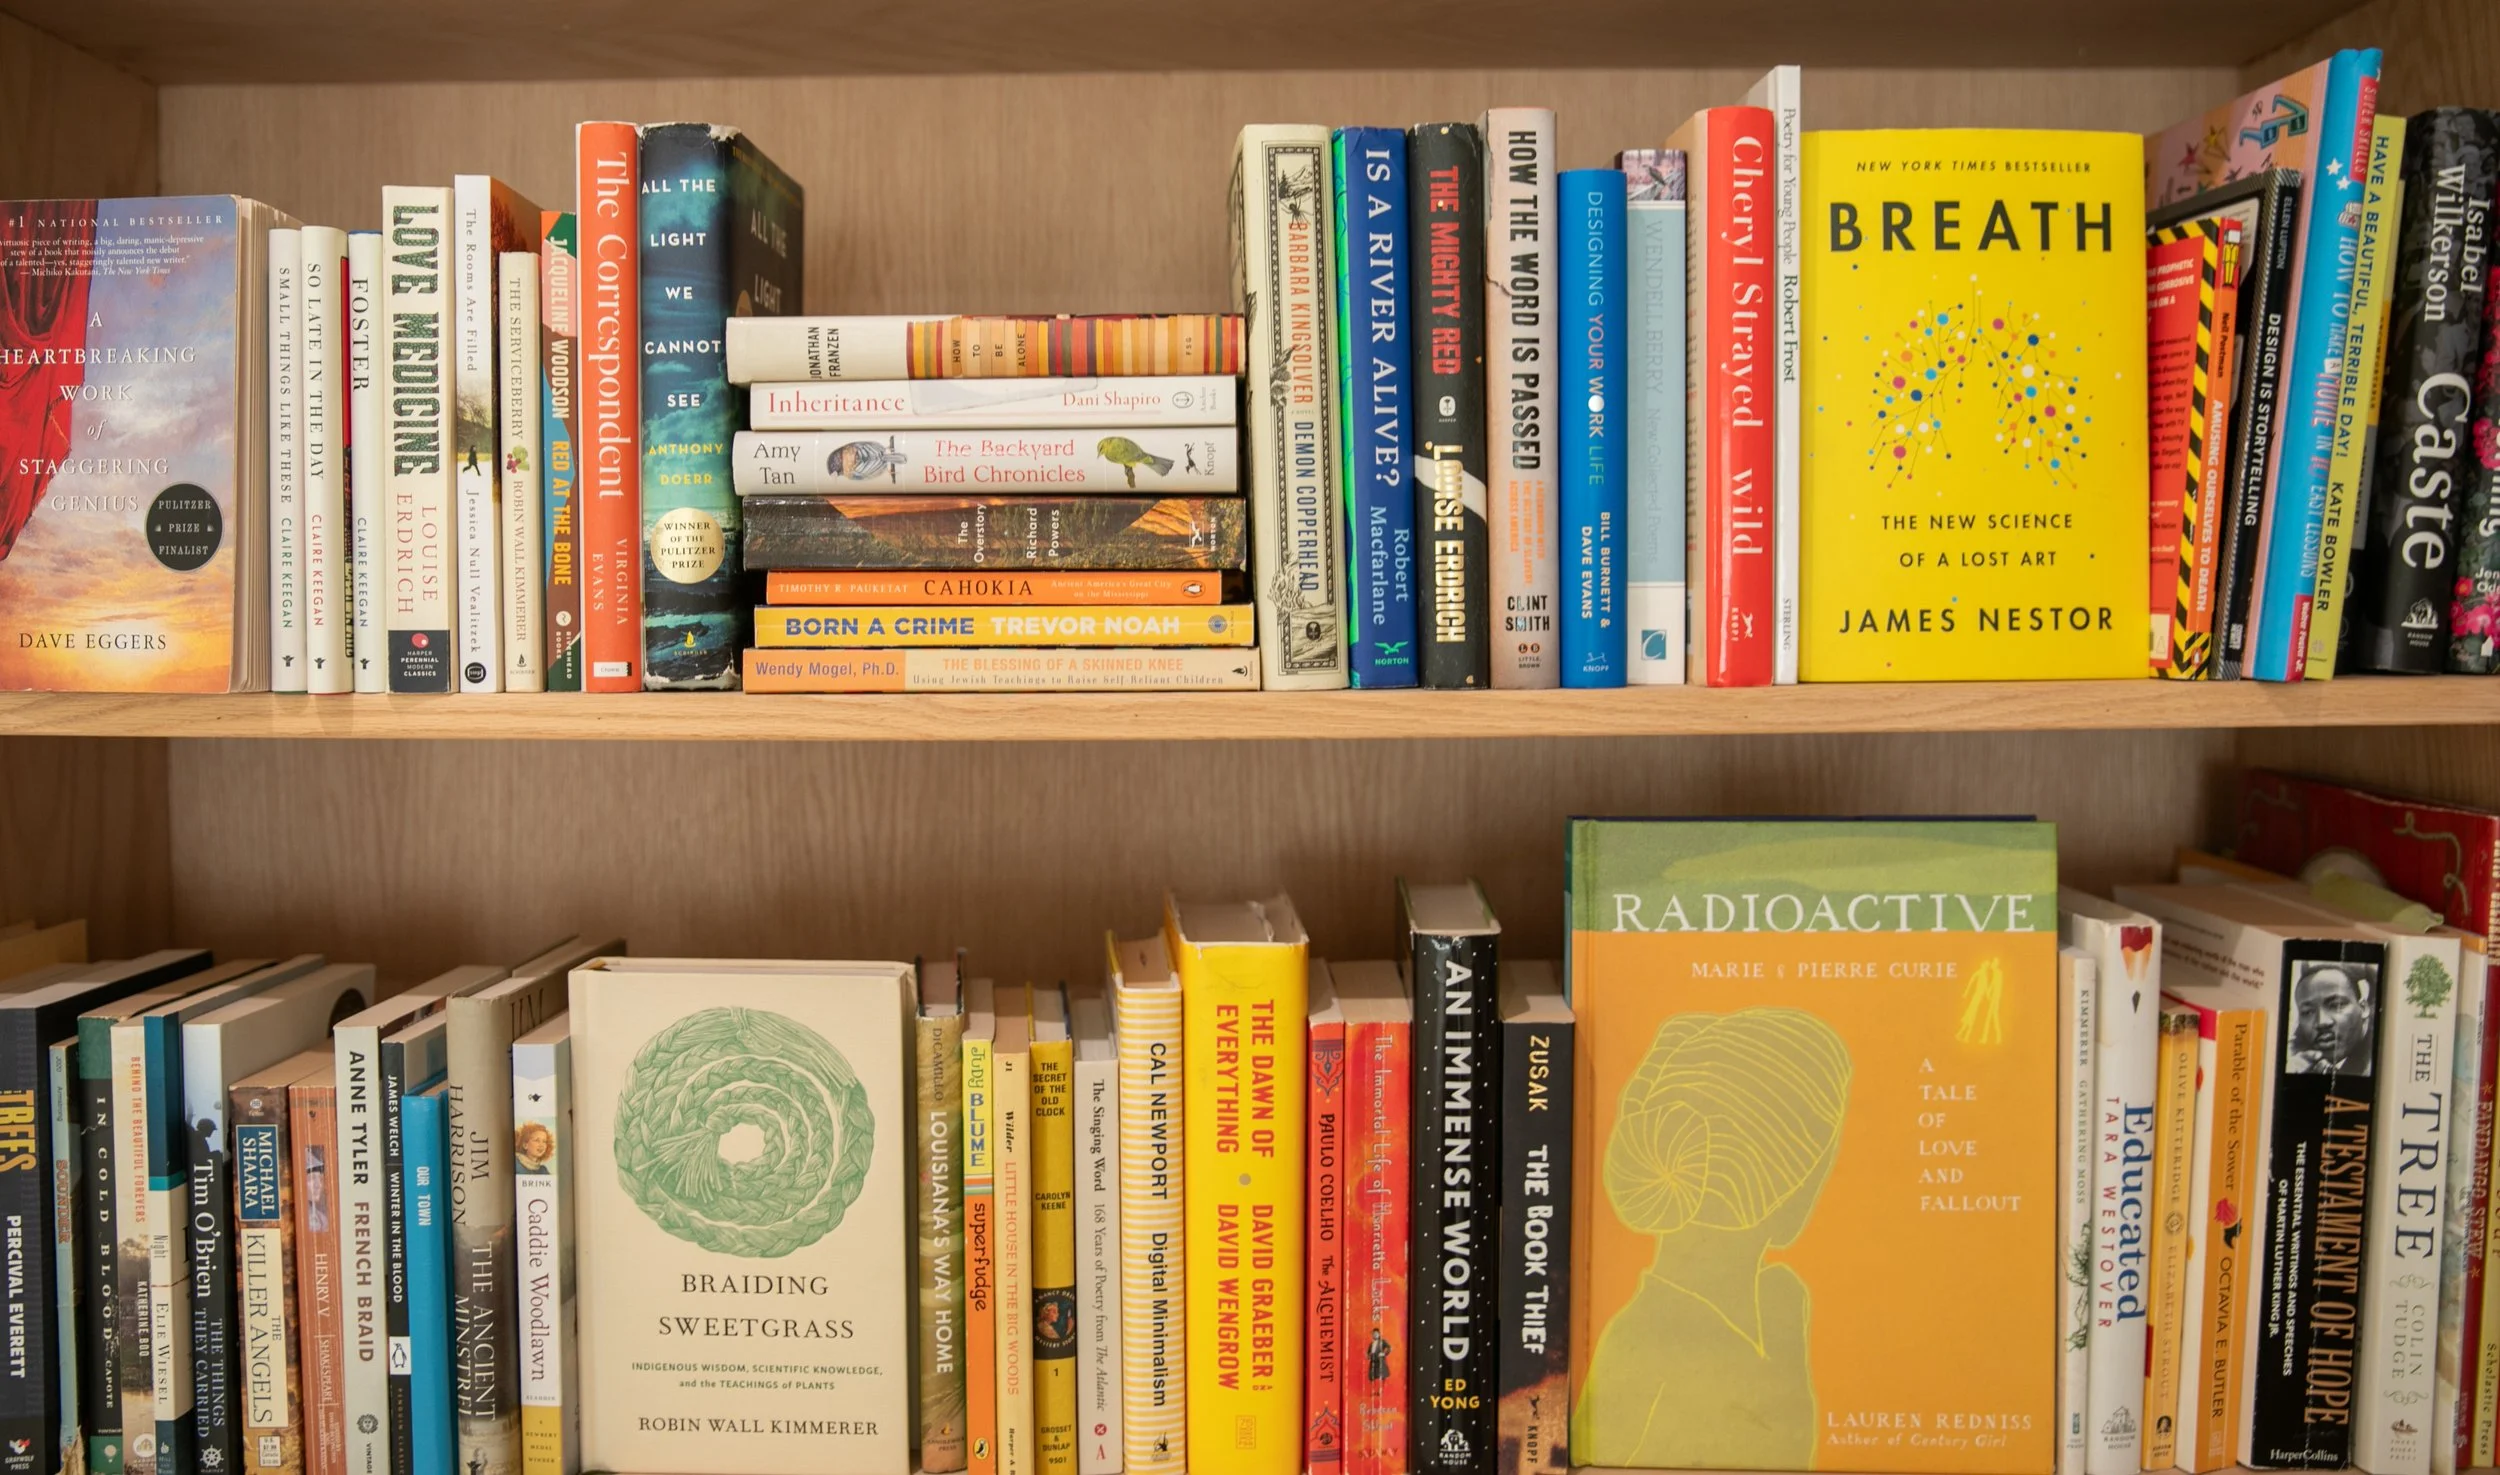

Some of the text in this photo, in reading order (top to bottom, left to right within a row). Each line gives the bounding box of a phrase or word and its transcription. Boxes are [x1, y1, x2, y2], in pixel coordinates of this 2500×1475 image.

[641, 179, 716, 193] ALL THE
[1857, 161, 2092, 173] NEW YORK TIMES BESTSELLER
[9, 215, 223, 228] #1 NATIONAL BESTSELLER
[650, 232, 706, 247] LIGHT
[1829, 199, 2113, 253] BREATH
[2423, 163, 2467, 323] Wilkerson
[2459, 195, 2491, 293] Isabel
[32, 268, 63, 276] Michiko
[65, 268, 101, 276] Kakutani,
[104, 267, 115, 275] The
[135, 267, 151, 275] York
[465, 209, 478, 372] The Rooms Are Filled
[665, 286, 693, 300] WE
[1430, 165, 1461, 374] THE MIGHTY RED
[1507, 130, 1541, 470] HOW THE WORD IS PASSED
[89, 311, 102, 327] A
[351, 279, 369, 393] FOSTER
[391, 204, 440, 477] LOVE MEDICINE
[589, 151, 632, 503] The Correspondent
[645, 341, 721, 354] CANNOT
[1366, 148, 1400, 488] IS A RIVER ALIVE?
[1720, 135, 1765, 556] Cheryl Strayed wild
[1782, 273, 1798, 383] Robert Frost
[0, 347, 196, 365] HEARTBREAKING
[279, 267, 292, 504] SMALL THINGS LIKE THESE
[59, 385, 133, 401] WORK
[548, 237, 572, 585] JACQUELINE WOODSON RED AT THE BONE
[667, 394, 701, 407] SEE
[768, 390, 1161, 413] Inheritance Dani Shapiro
[87, 419, 106, 440] of
[648, 443, 724, 456] ANTHONY
[754, 442, 801, 462] Amy
[935, 439, 1075, 459] The Backyard
[19, 458, 169, 476] STAGGERING
[660, 473, 713, 486] DOERR
[759, 467, 795, 485] Tan
[924, 466, 1086, 483] Bird Chronicles
[2400, 372, 2471, 571] Caste
[52, 495, 139, 512] GENIUS
[158, 500, 211, 511] PULITZER
[168, 523, 200, 533] PRIZE
[1293, 421, 1320, 592] DEMON COPPERHEAD
[1881, 512, 2073, 531] THE NEW SCIENCE
[158, 545, 208, 555] FINALIST
[397, 493, 414, 614] ERDRICH
[421, 505, 438, 601] LOUISE
[1581, 526, 1592, 620] DAVE EVANS
[1599, 511, 1610, 629] BILL BURNETT &
[923, 579, 1034, 597] CAHOKIA
[19, 632, 167, 650] DAVE EGGERS
[785, 616, 1181, 637] BORN A CRIME TREVOR NOAH
[1839, 607, 2114, 634] JAMES NESTOR
[1612, 893, 2036, 933] RADIOACTIVE
[1216, 1004, 1239, 1154] EVERYTHING
[1251, 1000, 1274, 1158] THE DAWN OF
[1528, 1035, 1550, 1112] ZUSAK
[242, 1137, 258, 1209] SHAARA
[258, 1131, 276, 1216] MICHAEL
[1442, 960, 1472, 1361] AN IMMENSE WORLD
[2394, 1092, 2442, 1261] TREE
[193, 1159, 220, 1299] Tim O'Brien
[349, 1050, 374, 1362] ANNE TYLER FRENCH BRAID
[1148, 1042, 1168, 1407] CAL NEWPORT Digital Minimalism
[2097, 1098, 2120, 1329] TARA WESTOVER
[2115, 1100, 2154, 1323] Educated
[969, 1202, 992, 1312] superfudge
[1522, 1144, 1553, 1355] THE BOOK THIEF
[2304, 1094, 2370, 1425] A TESTAMENT OF HOPE
[6, 1215, 25, 1379] PERCIVAL EVERETT
[527, 1199, 550, 1381] Caddie Woodlawn
[681, 1273, 830, 1296] BRAIDING
[658, 1316, 855, 1339] SWEETGRASS
[632, 1362, 883, 1376] INDIGENOUS WISDOM, SCIENTIFIC KNOWLEDGE,
[638, 1416, 879, 1436] ROBIN WALL KIMMERER
[1827, 1411, 2033, 1431] LAUREN REDNISS
